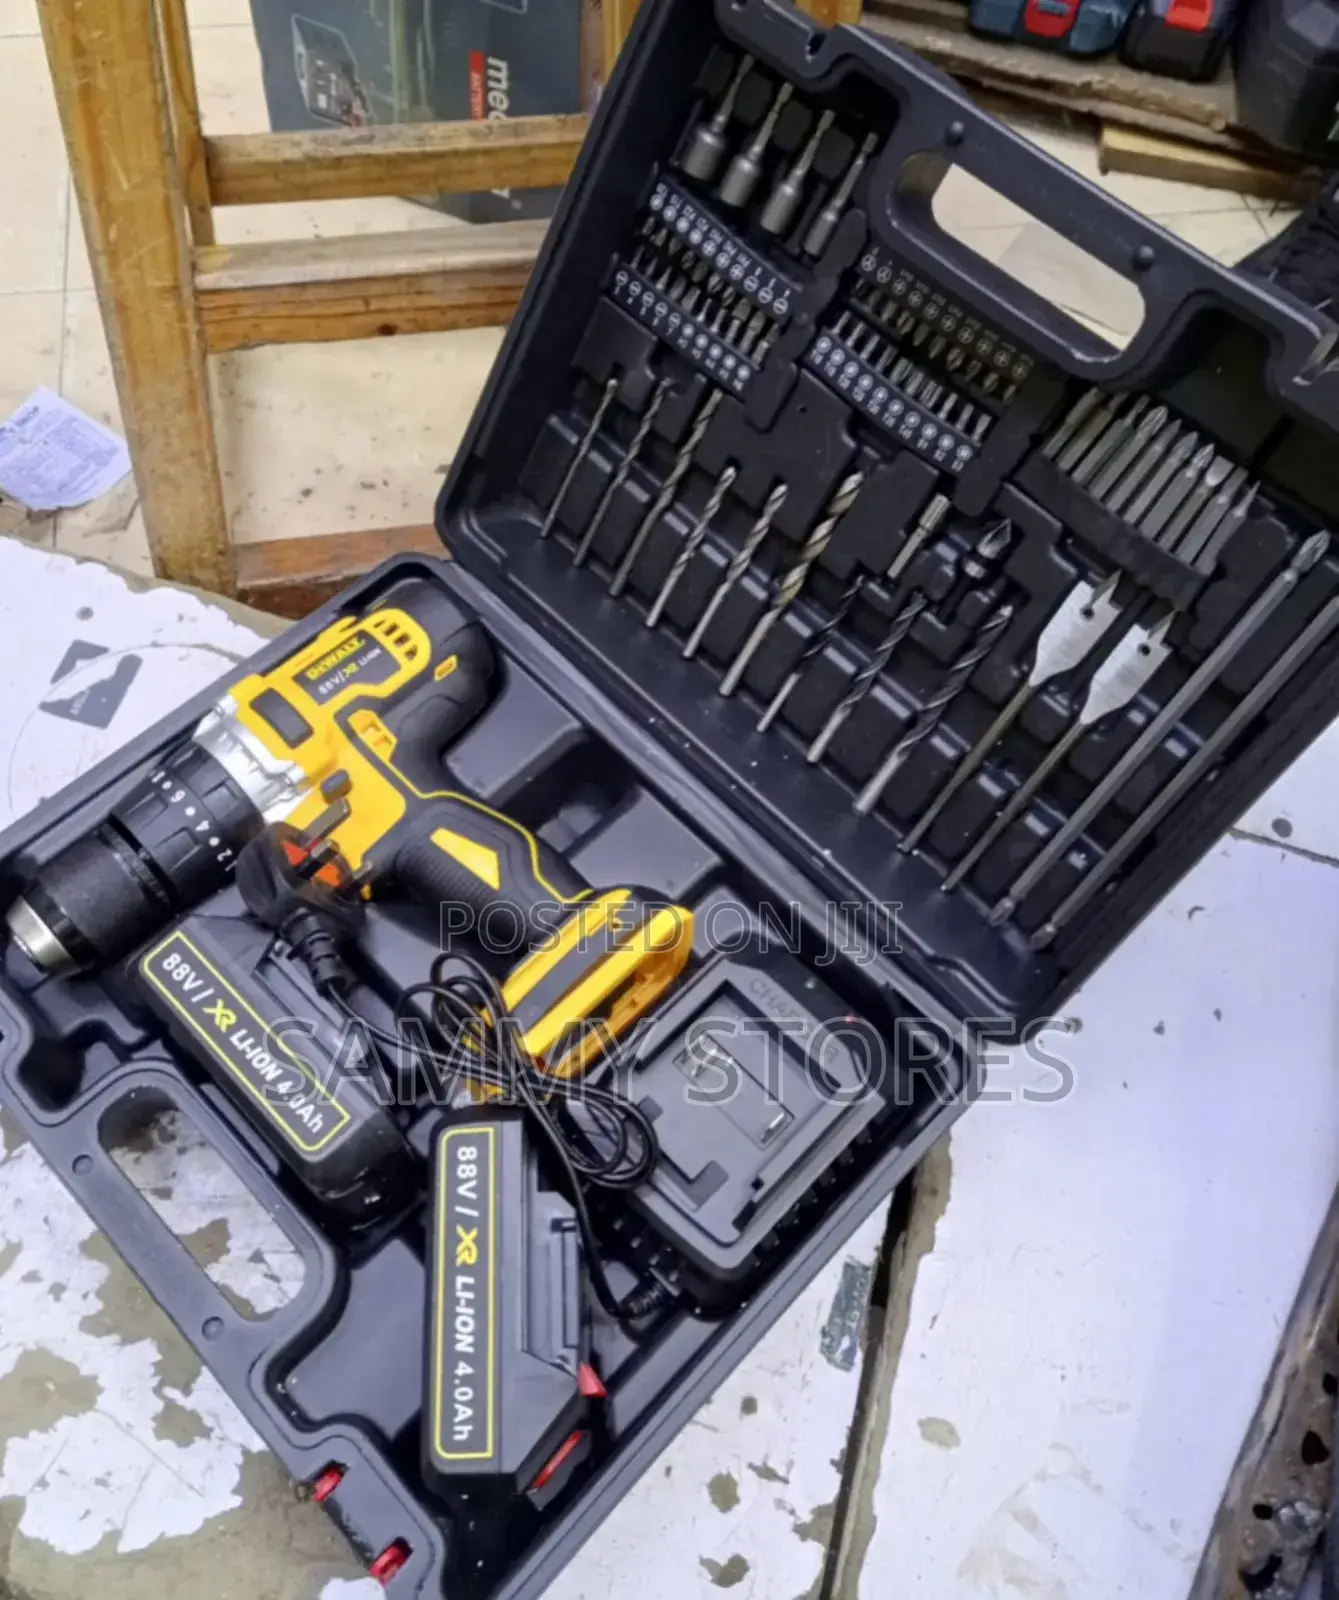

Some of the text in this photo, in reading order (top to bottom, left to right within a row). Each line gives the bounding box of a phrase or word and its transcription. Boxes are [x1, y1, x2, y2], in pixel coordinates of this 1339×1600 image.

[195, 819, 210, 832] 4
[162, 952, 204, 991] 88V
[202, 998, 238, 1034] XR
[229, 1028, 283, 1082] LI-ION
[277, 1080, 324, 1134] 4.0Ah
[456, 1146, 479, 1200] 88V
[456, 1223, 479, 1267] XR
[454, 1275, 476, 1353] LI-ION
[452, 1360, 475, 1442] 4.0Ah
